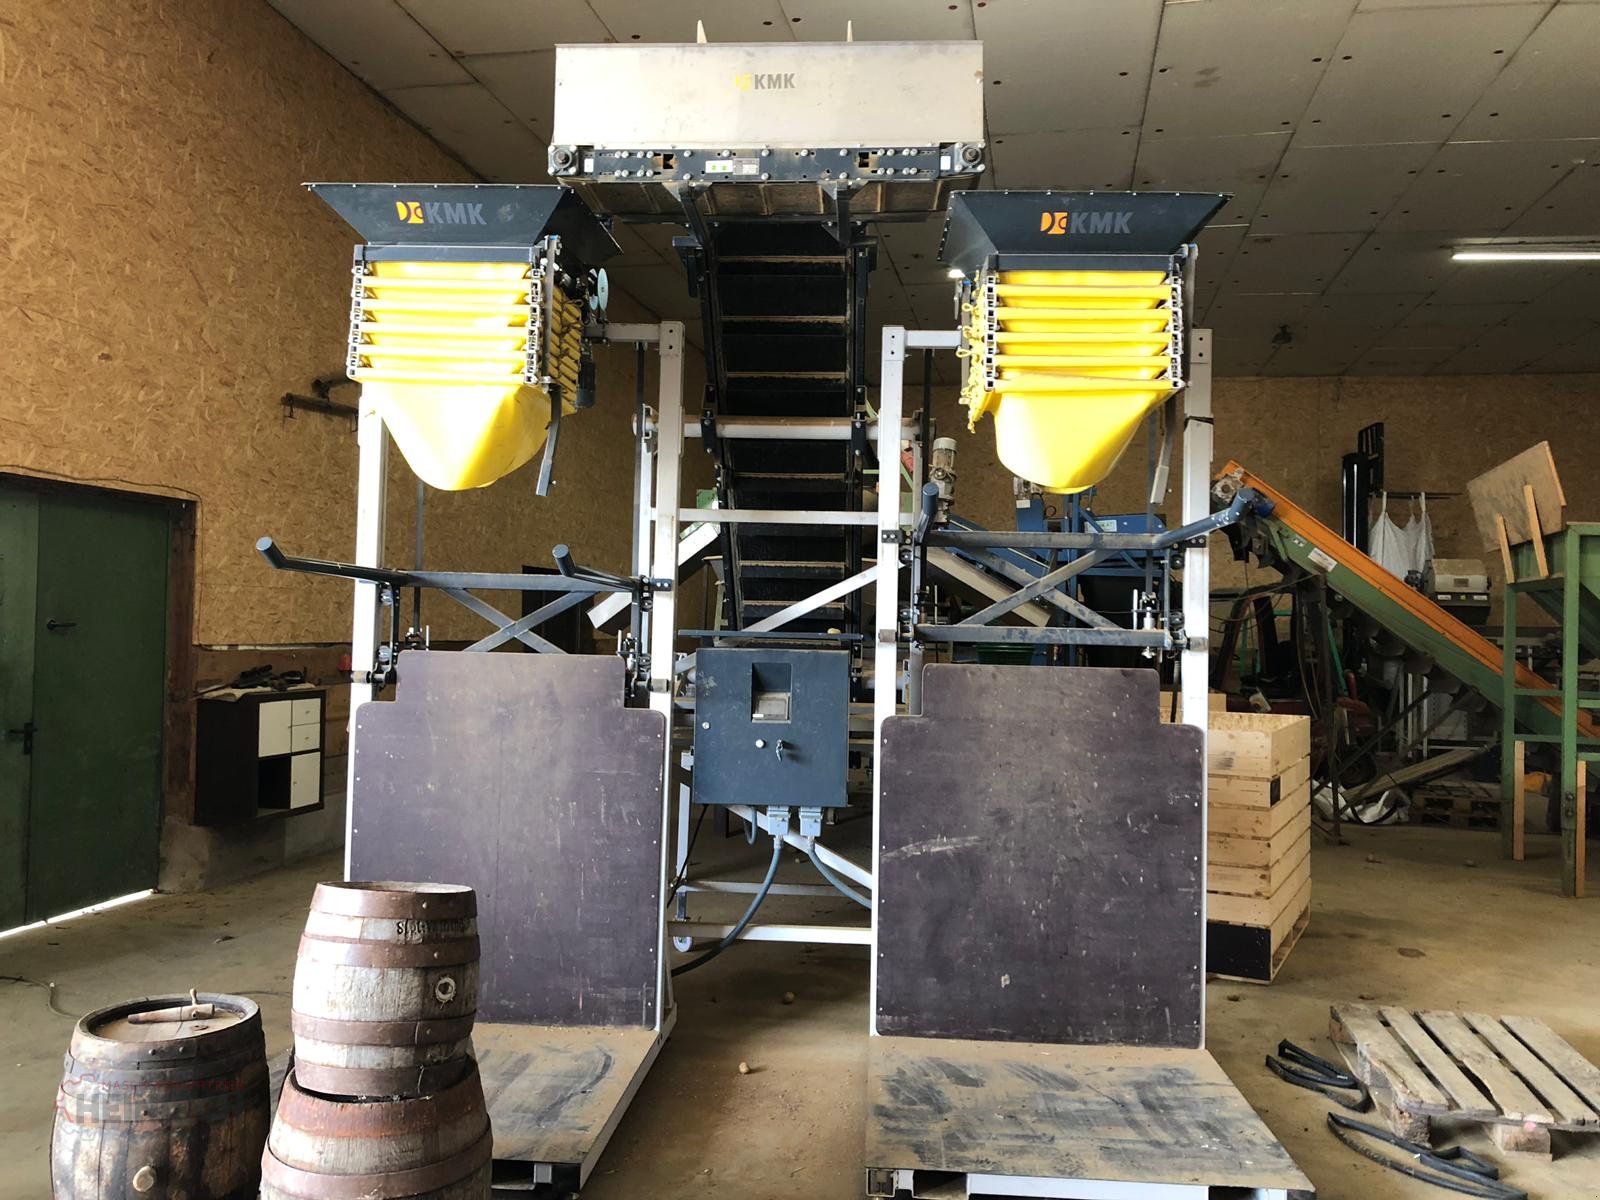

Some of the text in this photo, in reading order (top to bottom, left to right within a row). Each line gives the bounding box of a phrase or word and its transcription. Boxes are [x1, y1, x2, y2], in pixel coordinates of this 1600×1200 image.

[754, 73, 796, 90] KMK
[424, 202, 488, 225] KMK
[1070, 211, 1134, 234] KMK
